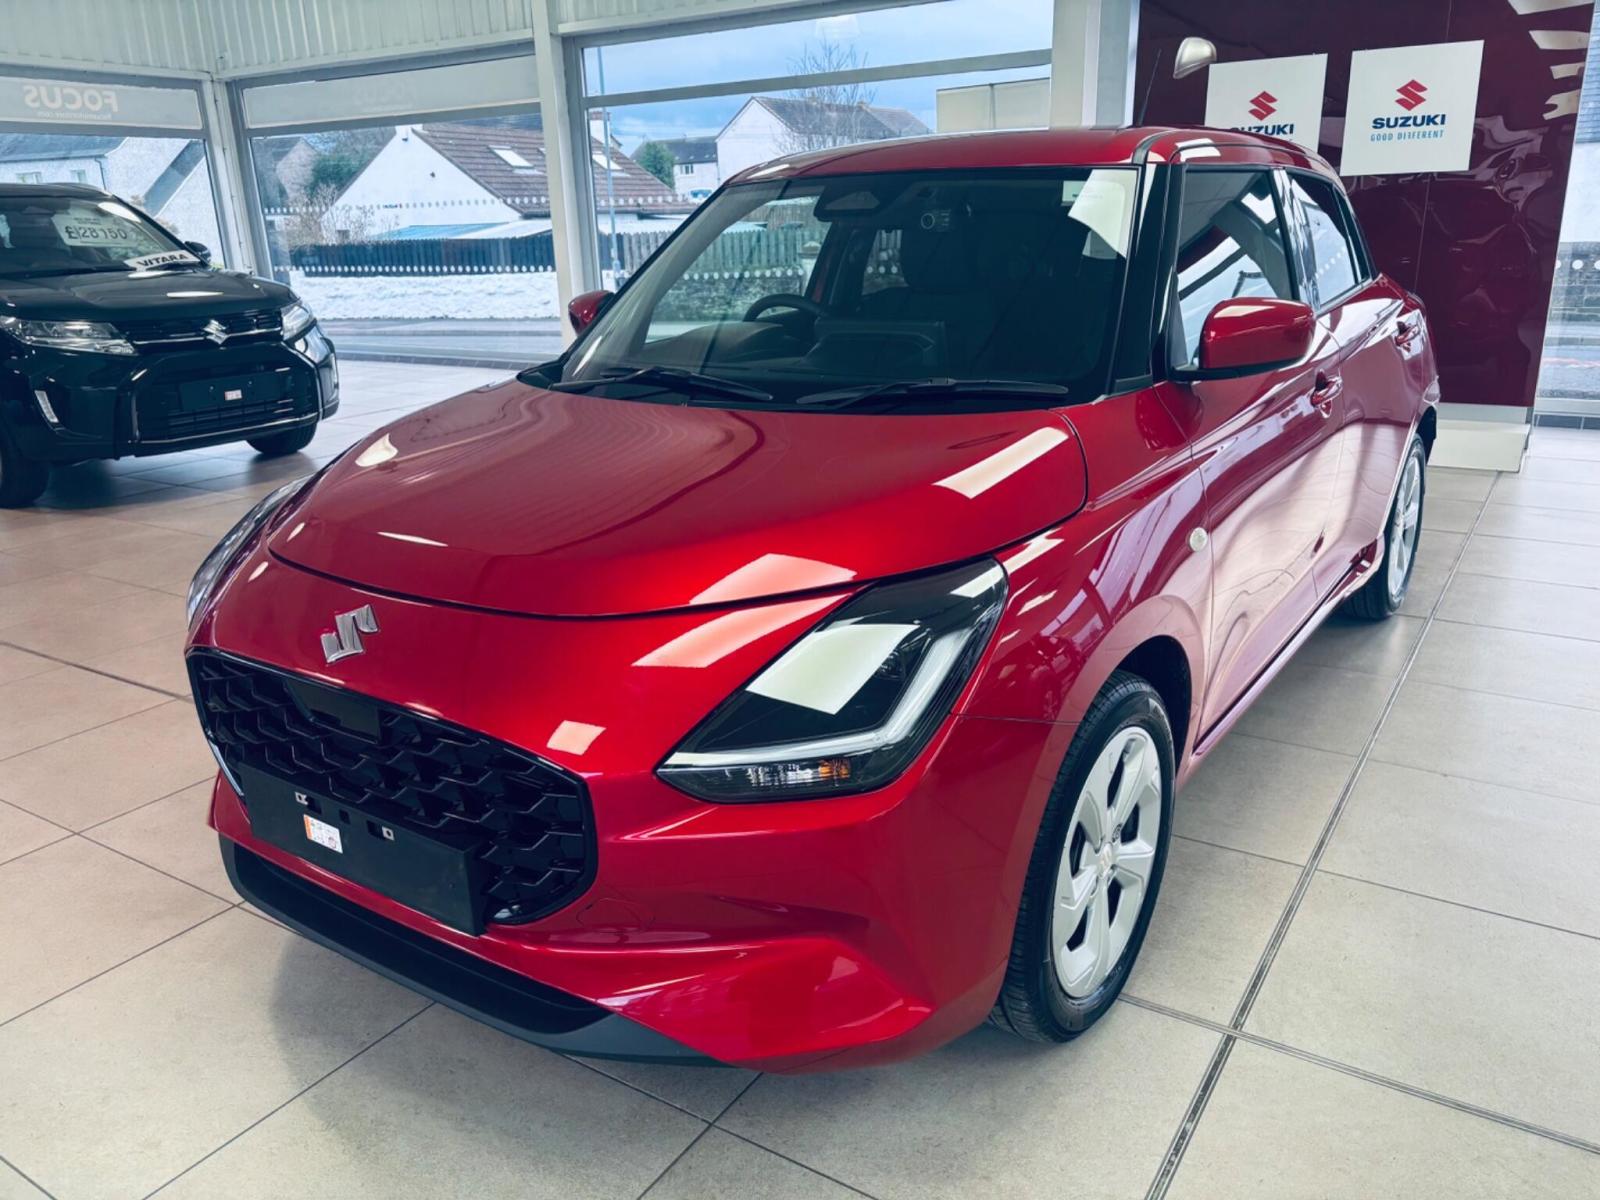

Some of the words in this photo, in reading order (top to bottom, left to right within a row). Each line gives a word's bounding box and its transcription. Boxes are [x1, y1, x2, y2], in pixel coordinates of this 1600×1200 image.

[1372, 113, 1446, 129] SUZUKI
[1370, 132, 1394, 142] GOOD
[1397, 129, 1445, 140] DIFFERENT
[136, 253, 189, 267] VITARA
